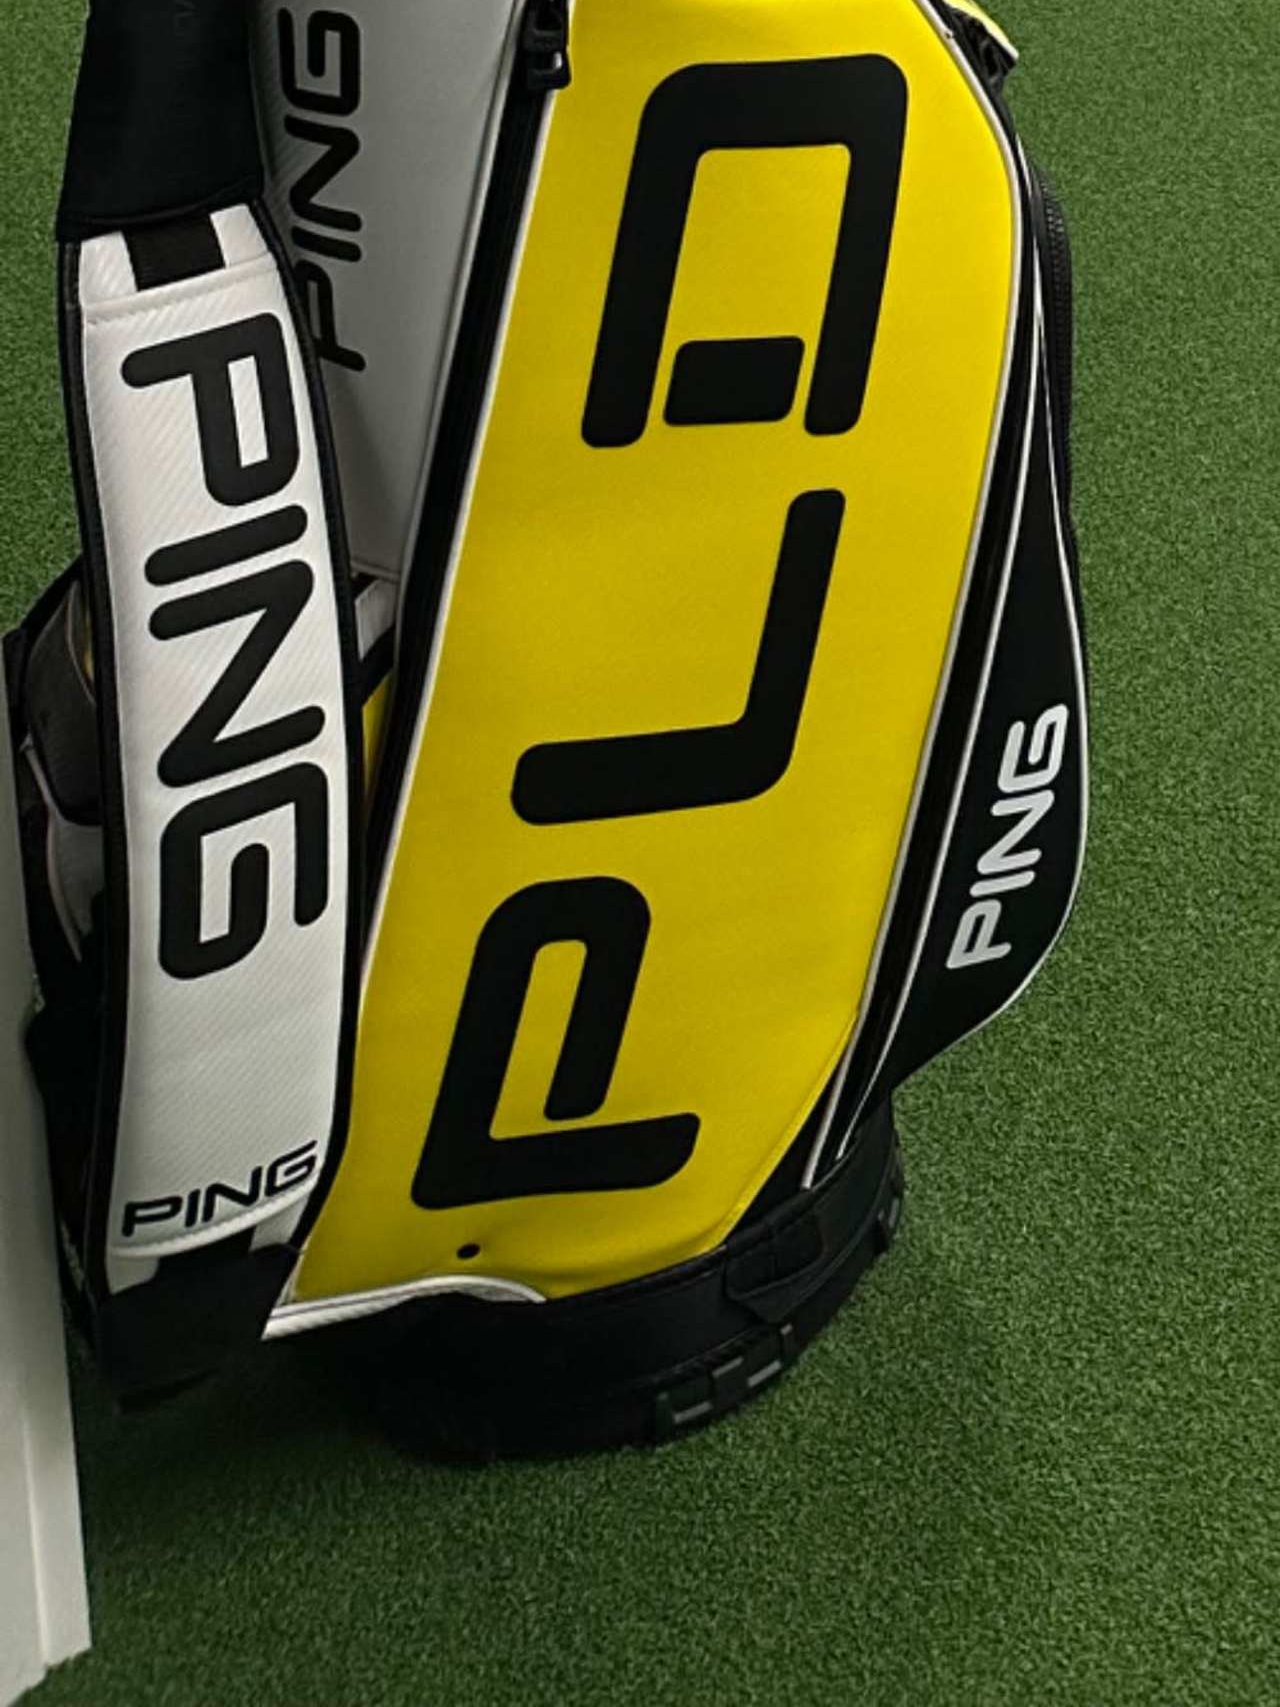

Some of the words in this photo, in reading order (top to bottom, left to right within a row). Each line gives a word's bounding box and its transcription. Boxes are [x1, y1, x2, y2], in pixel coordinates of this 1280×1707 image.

[273, 5, 364, 374] PING
[122, 312, 332, 982] PING
[945, 700, 1070, 972] PING
[120, 1139, 319, 1238] PING
